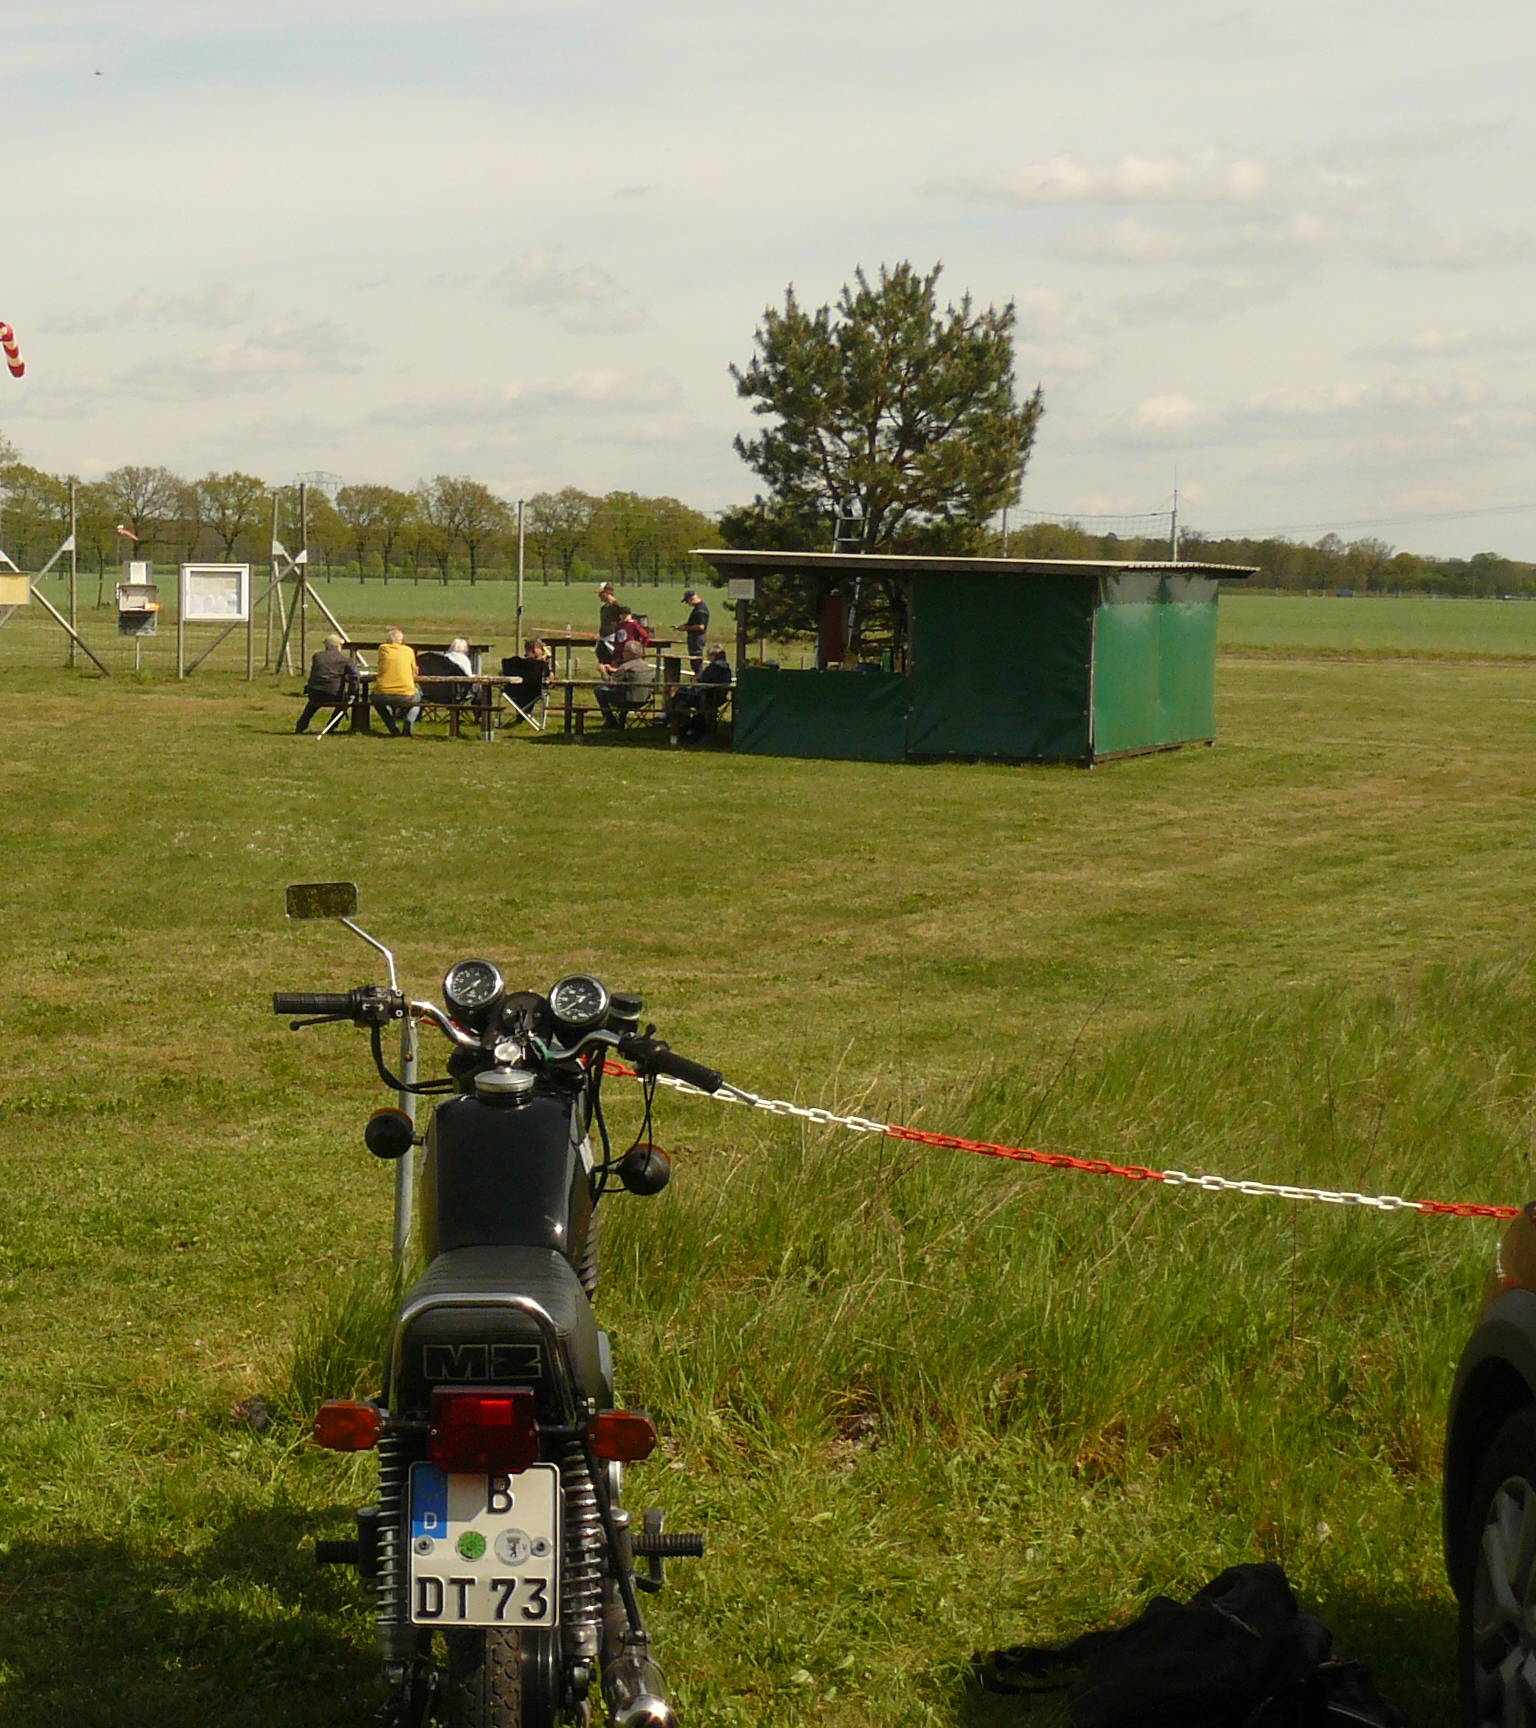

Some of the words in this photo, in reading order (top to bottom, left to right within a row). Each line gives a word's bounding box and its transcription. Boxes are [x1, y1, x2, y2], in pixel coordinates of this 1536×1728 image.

[424, 1344, 542, 1380] MZ
[487, 1474, 514, 1514] B
[423, 1512, 437, 1530] D
[417, 1576, 477, 1619] DT
[490, 1577, 548, 1619] 73
